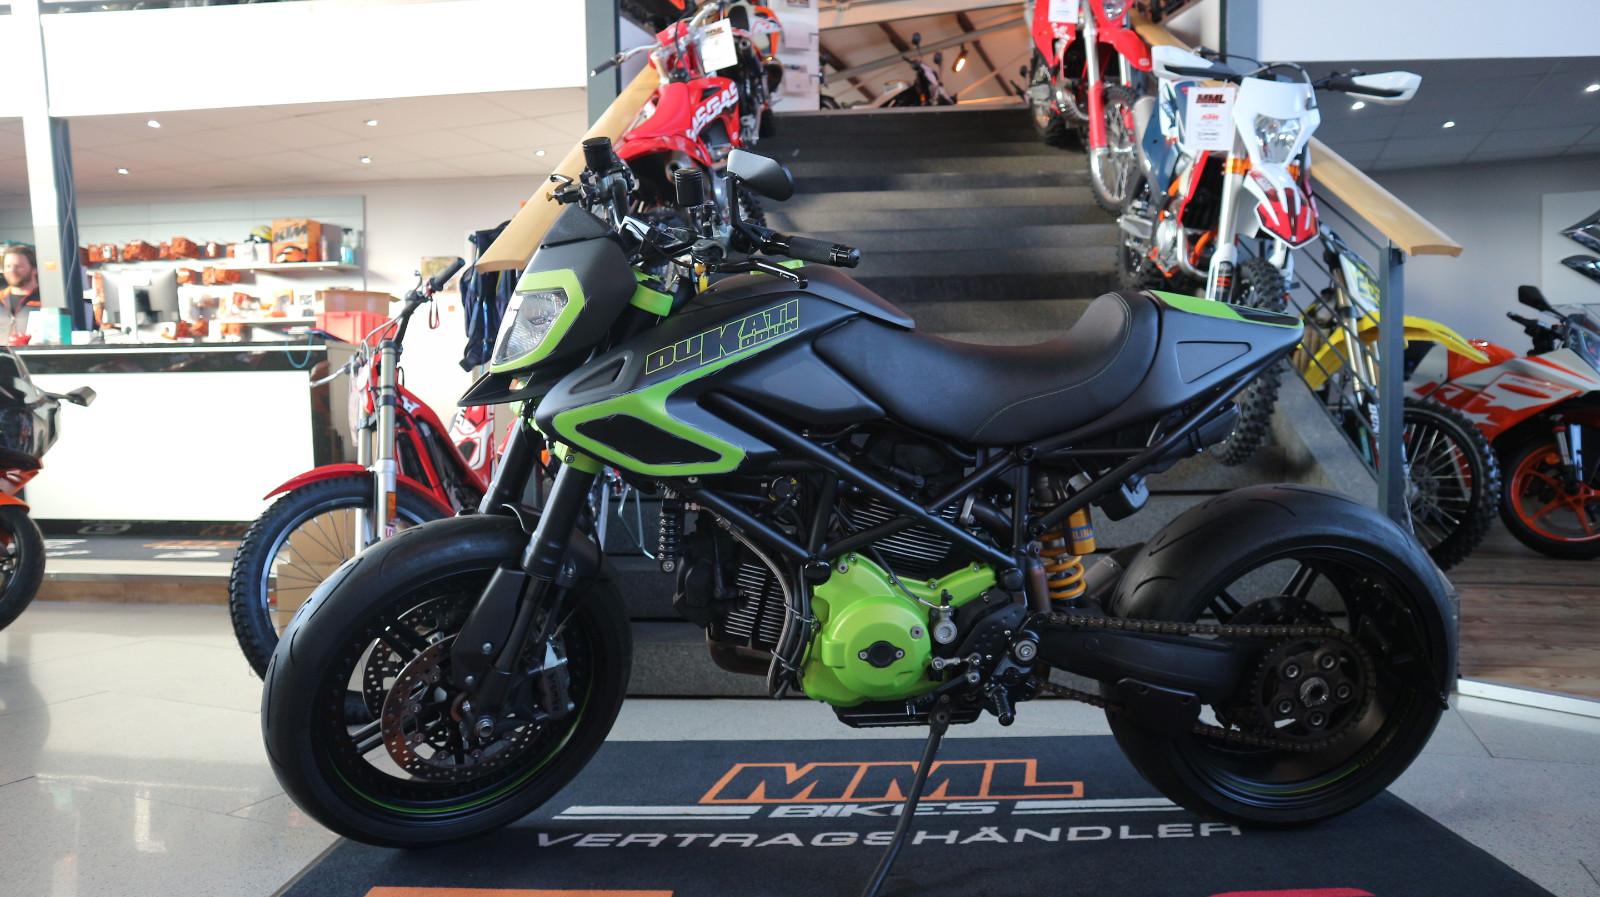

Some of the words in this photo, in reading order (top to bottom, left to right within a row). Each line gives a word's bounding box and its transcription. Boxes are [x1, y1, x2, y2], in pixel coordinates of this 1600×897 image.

[697, 758, 1084, 804] MML
[768, 800, 1000, 818] BIKES
[537, 822, 1241, 848] VERTRAGSHÄNDLER
